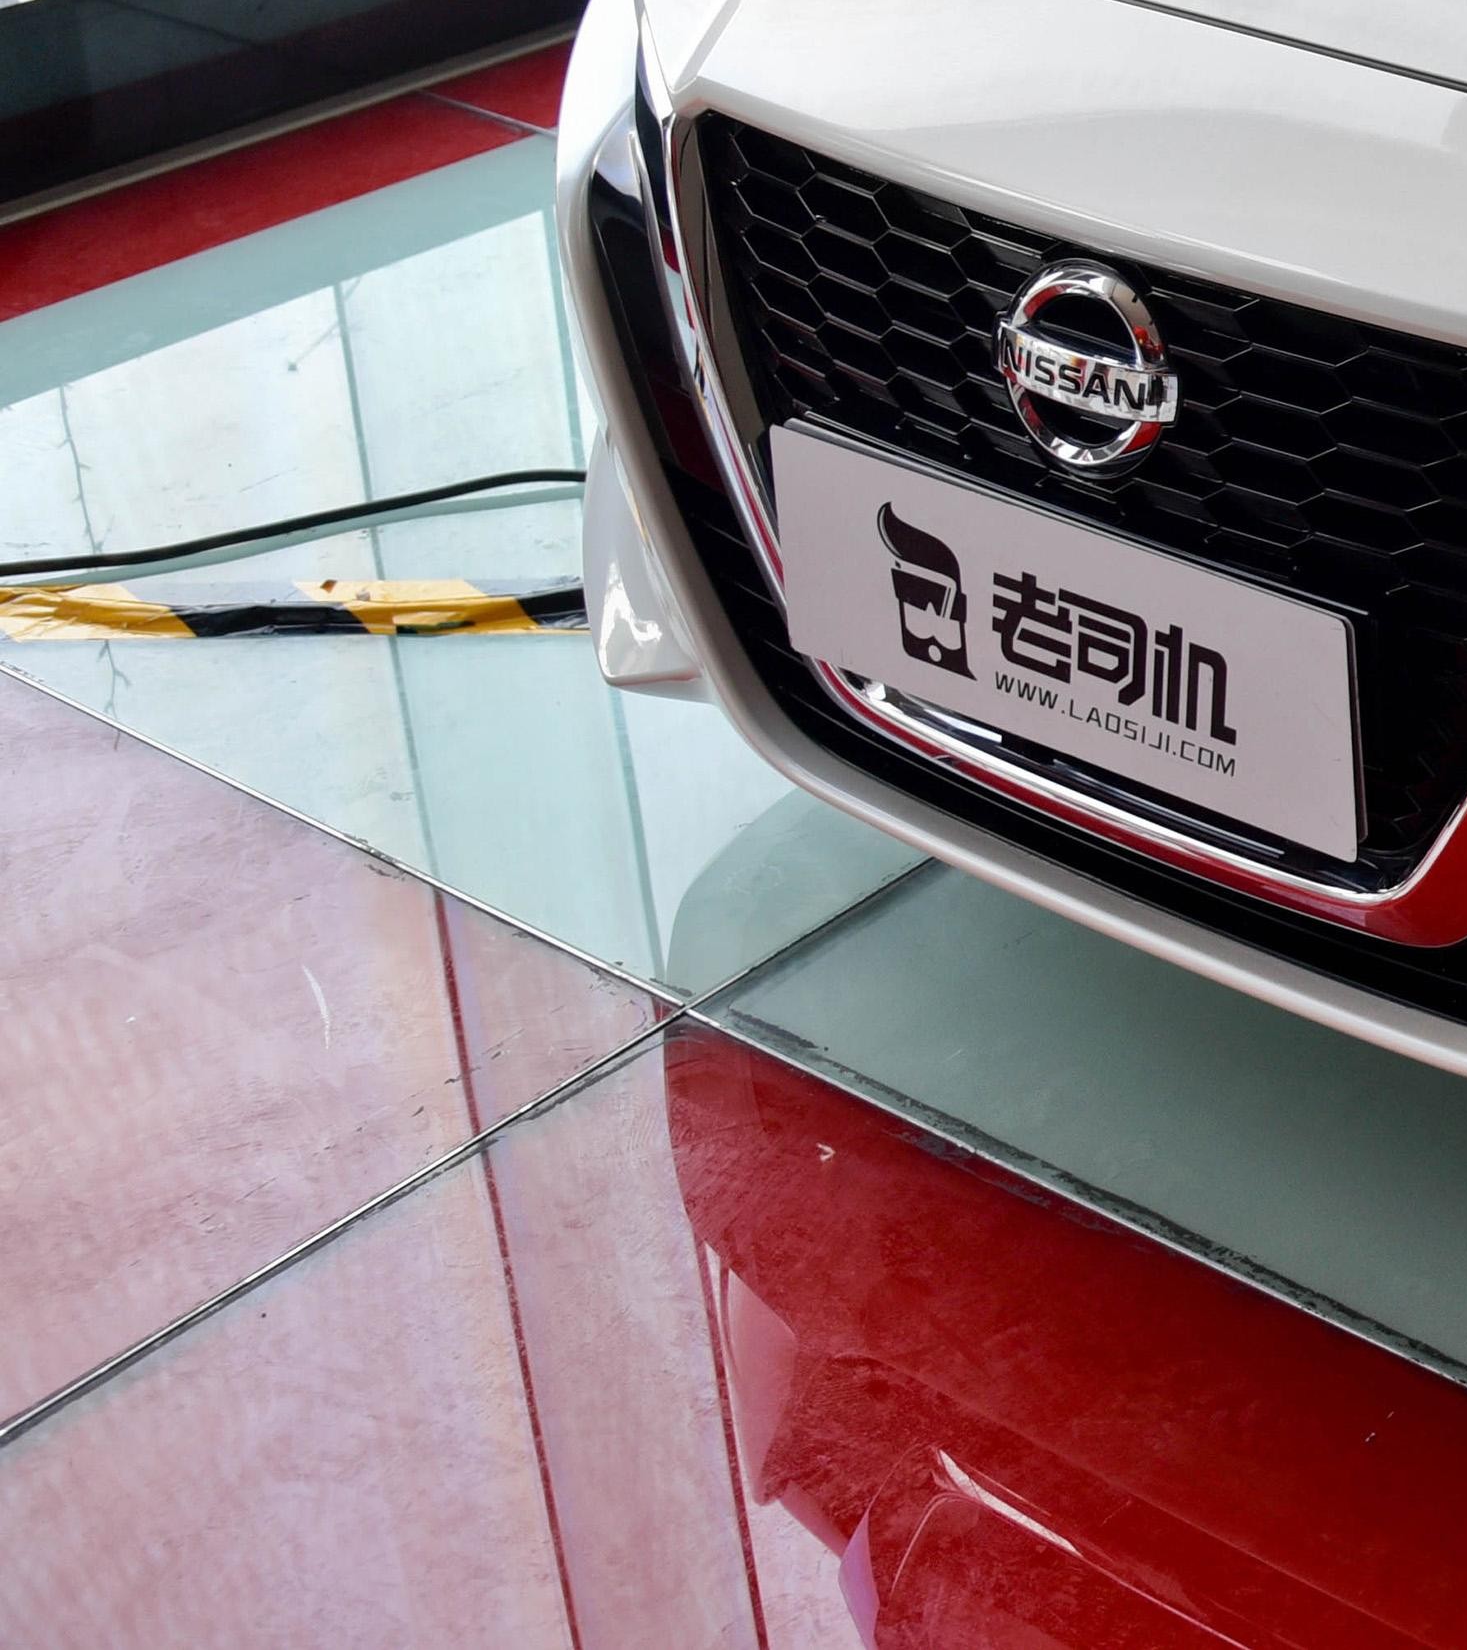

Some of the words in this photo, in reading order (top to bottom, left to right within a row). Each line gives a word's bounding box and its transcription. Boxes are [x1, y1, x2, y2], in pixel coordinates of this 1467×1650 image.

[1000, 326, 1146, 411] NISSAN
[992, 571, 1237, 745] 老司机
[995, 671, 1236, 777] WWW.LAOSIJI.COM
